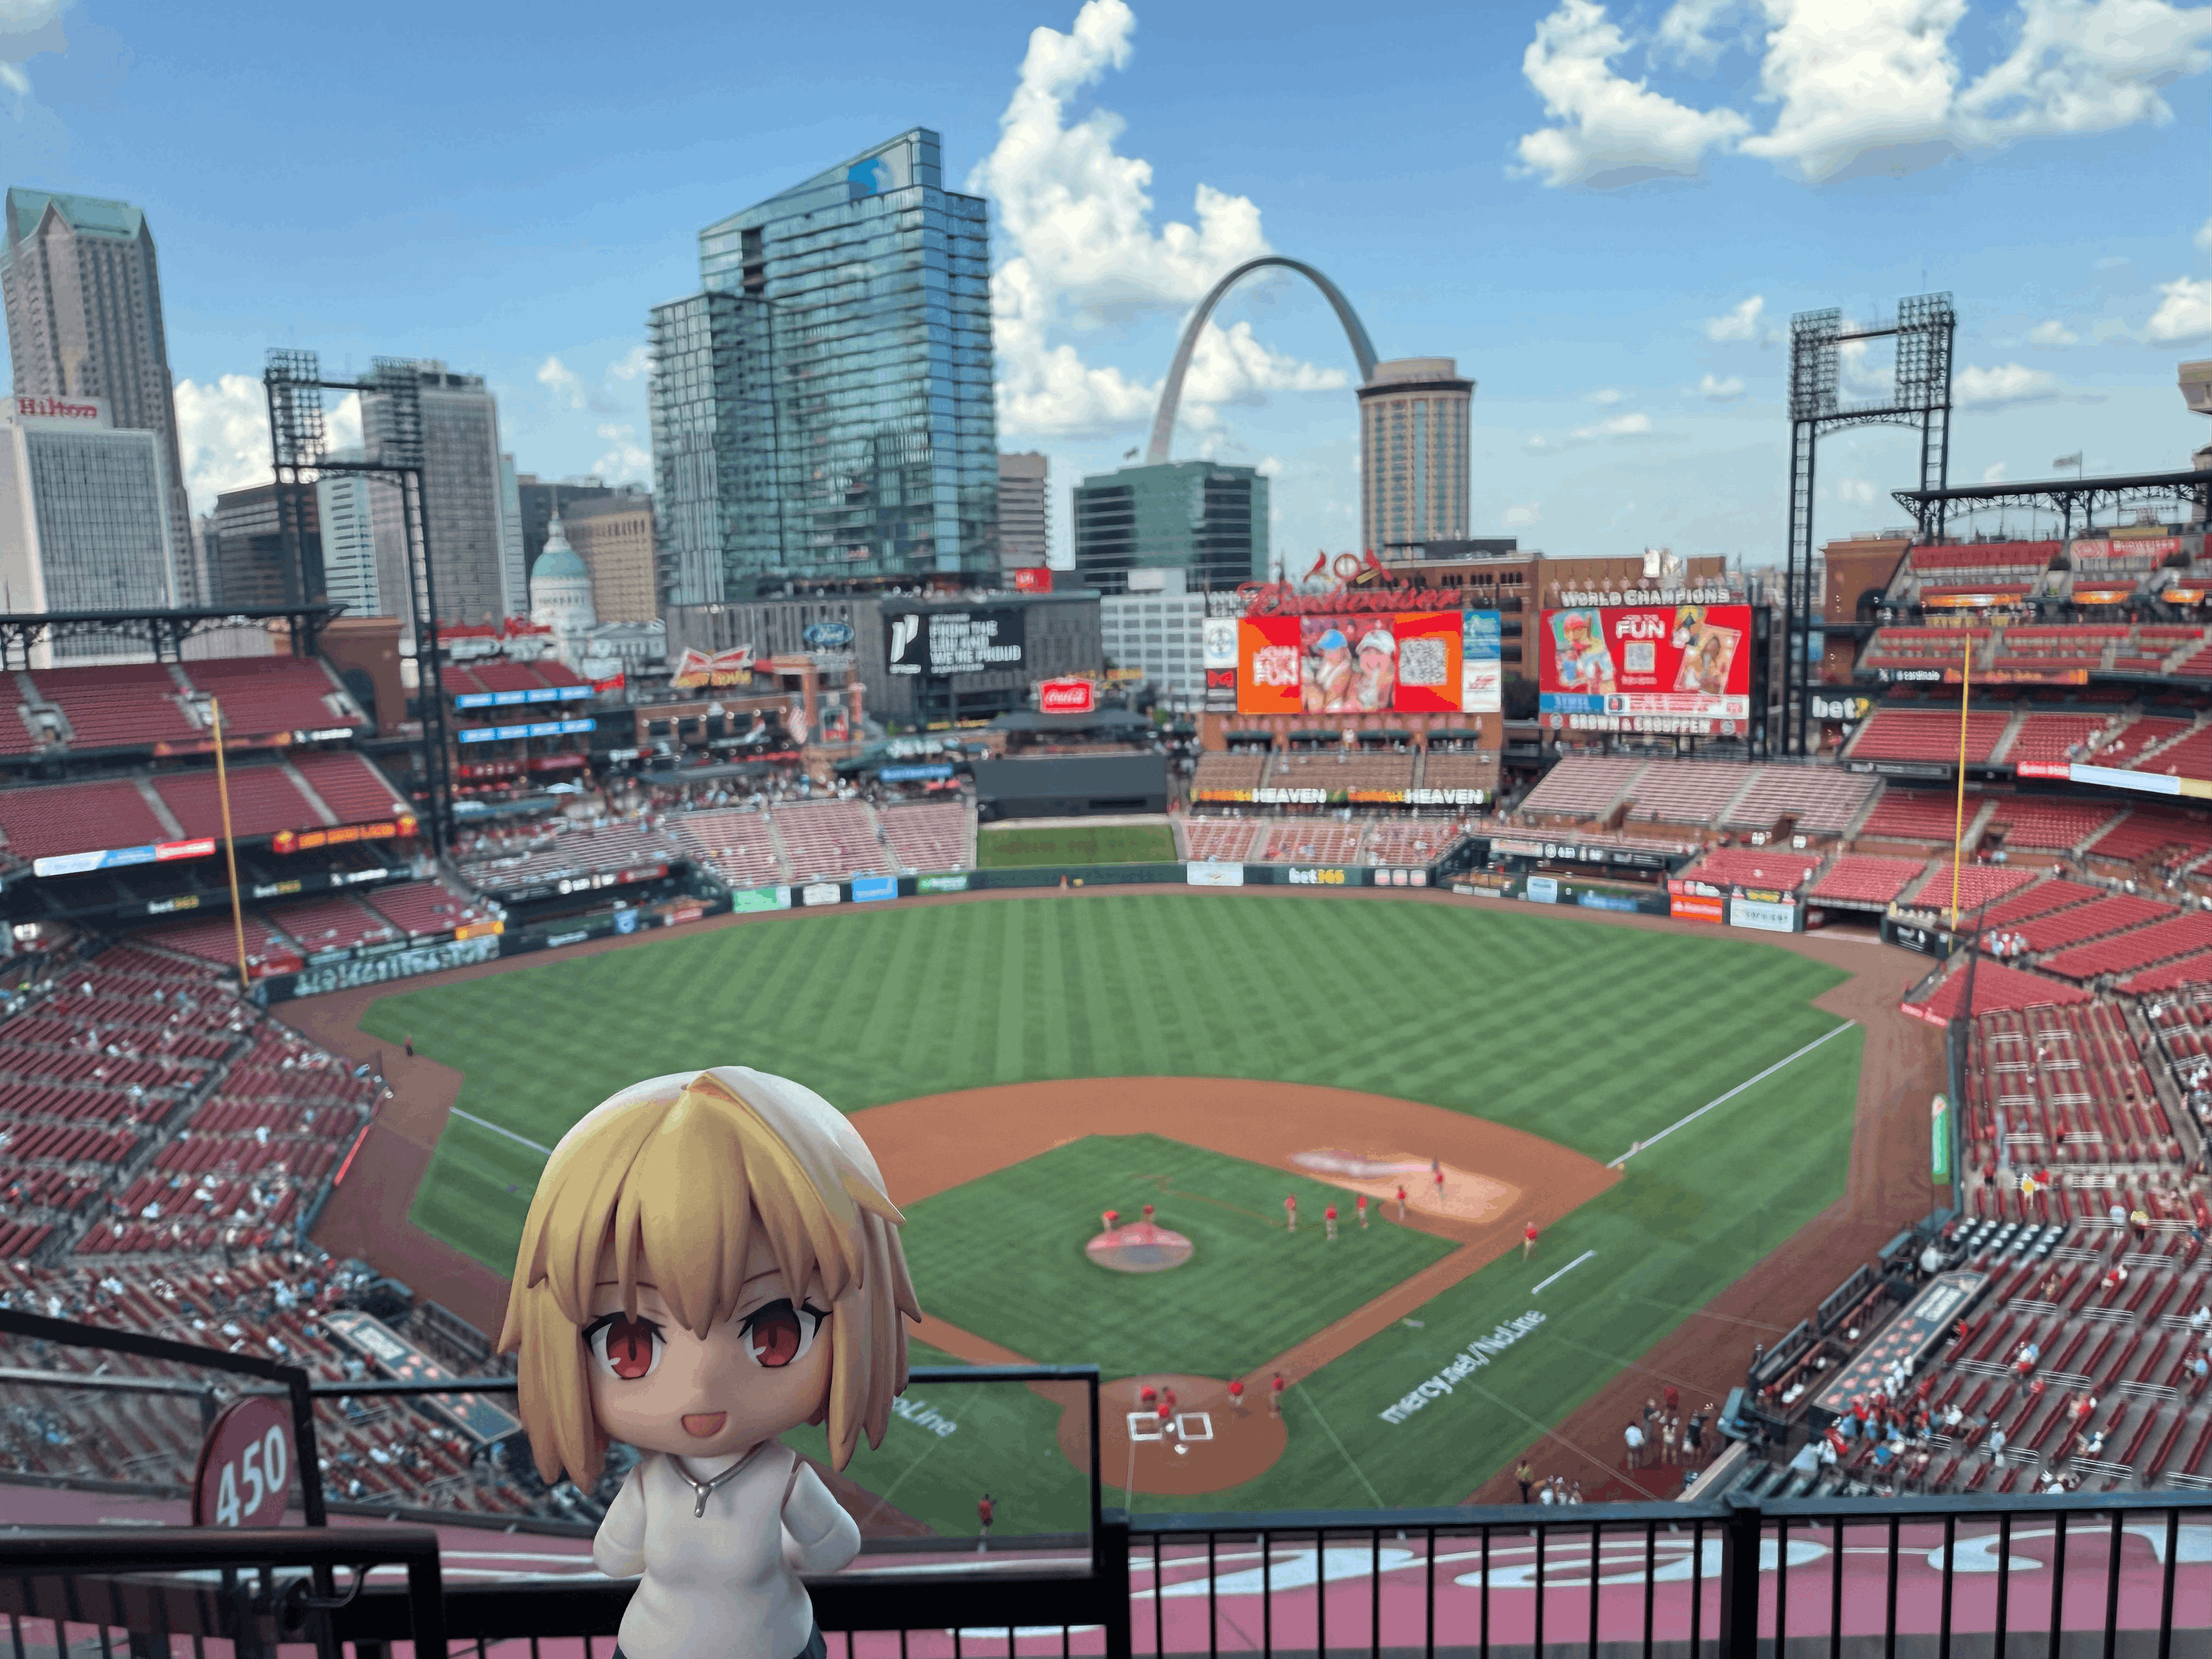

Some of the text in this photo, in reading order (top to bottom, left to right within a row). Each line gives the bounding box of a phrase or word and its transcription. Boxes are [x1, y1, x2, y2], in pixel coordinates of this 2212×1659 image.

[19, 397, 97, 418] Hilton
[1561, 588, 1730, 607] WORLD CHAMPIONS
[1616, 619, 1666, 639] FUN
[1252, 788, 1327, 803] HEAVEN
[1405, 788, 1484, 804] HEAVEN
[216, 1425, 287, 1527] 450
